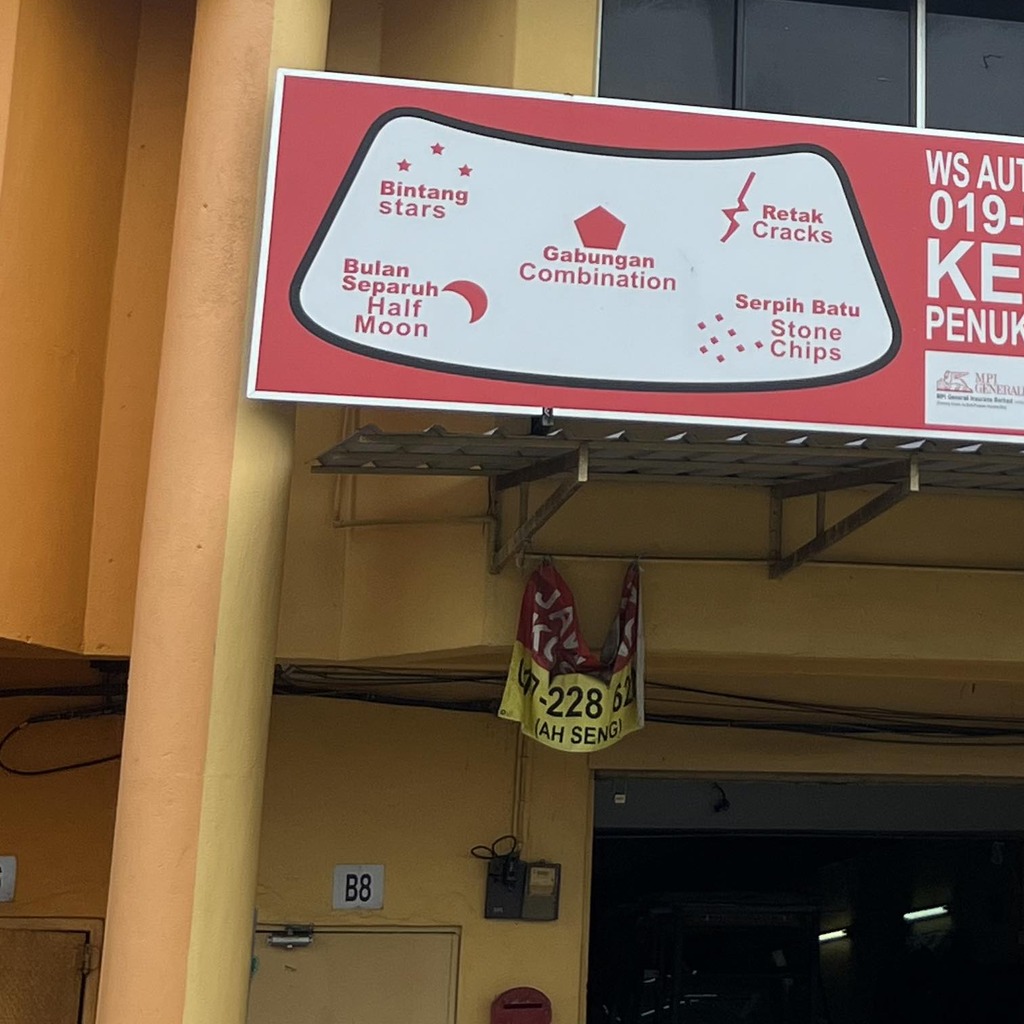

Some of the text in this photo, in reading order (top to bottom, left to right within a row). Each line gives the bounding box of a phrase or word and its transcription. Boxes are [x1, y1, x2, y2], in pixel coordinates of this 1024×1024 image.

[925, 149, 970, 188] WS
[379, 180, 469, 206] Bintang
[378, 197, 446, 219] stars
[762, 204, 824, 224] Retak
[751, 220, 833, 244] Cracks
[343, 258, 410, 278] Bulan
[543, 245, 655, 270] Gabungan
[342, 275, 439, 298] Separuh
[519, 262, 677, 291] Combination
[366, 296, 422, 317] Half
[735, 293, 861, 318] Serpih Batu
[354, 315, 429, 338] Moon
[770, 319, 843, 342] Stone
[770, 340, 842, 363] Chips
[975, 372, 998, 385] MPI
[535, 718, 623, 745] (AH SENG)
[345, 873, 372, 903] B8
